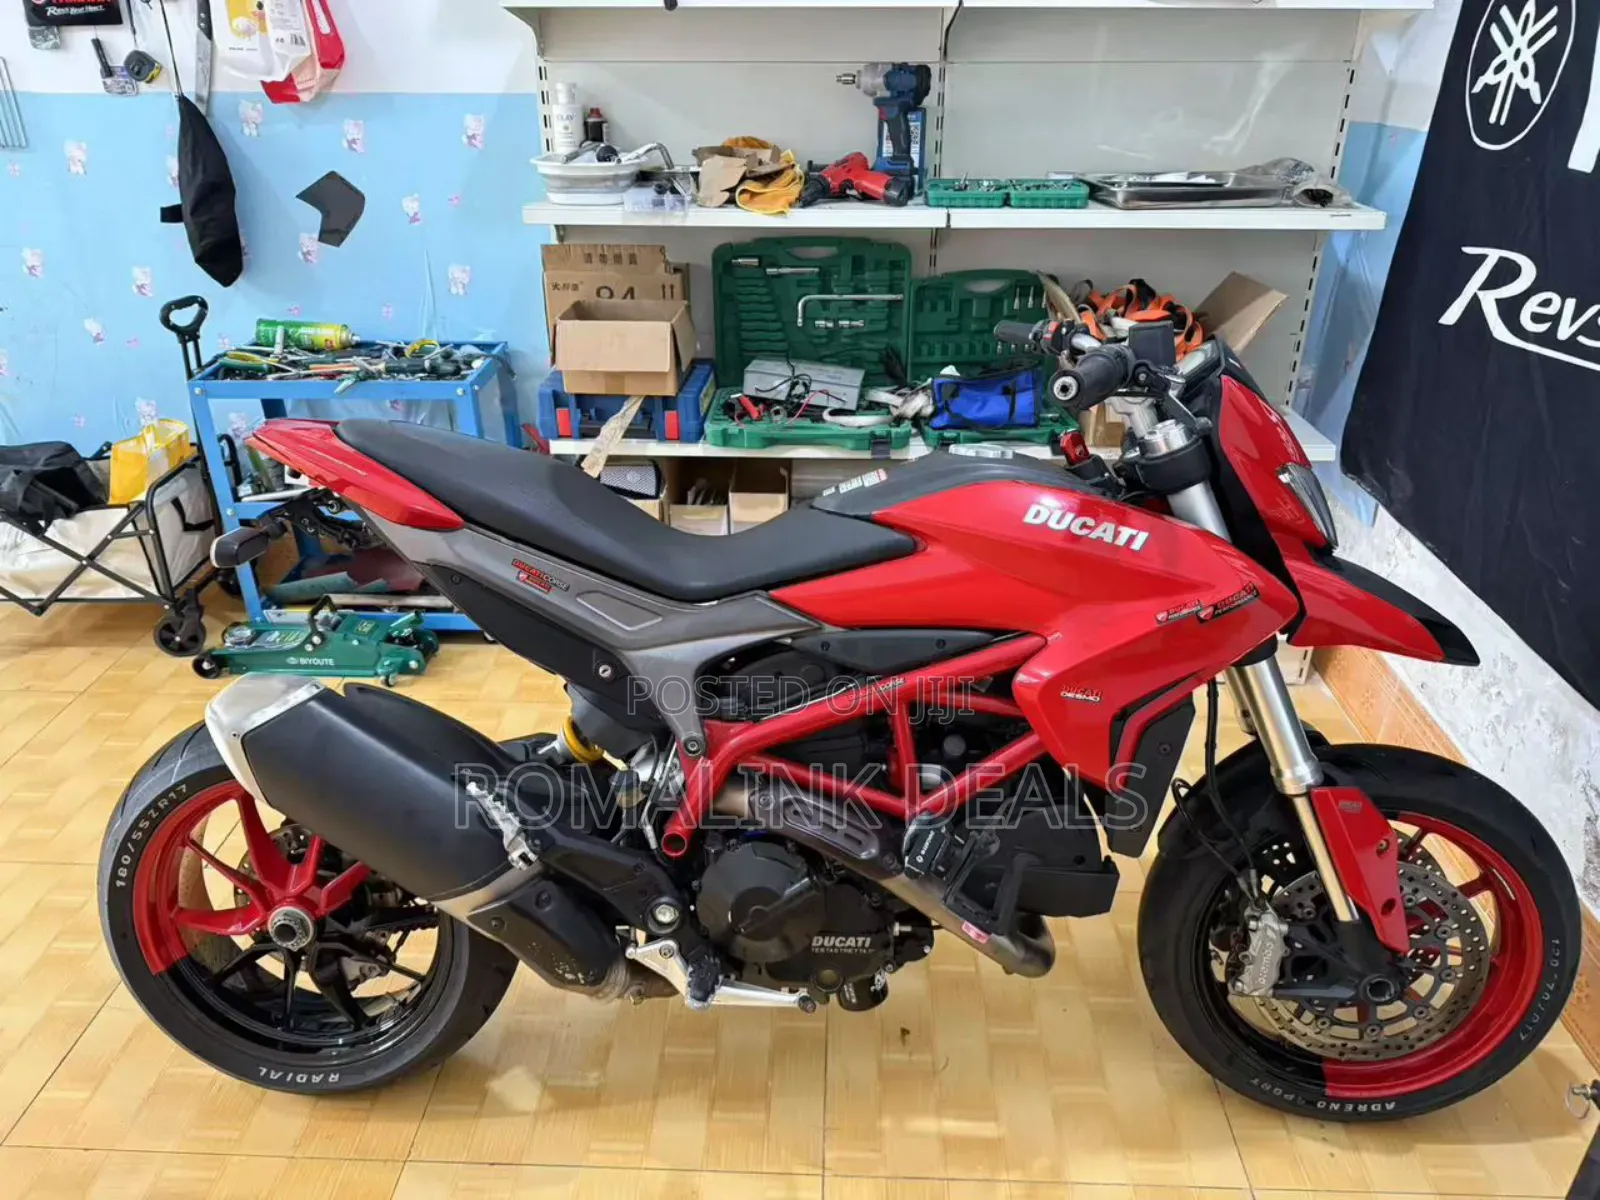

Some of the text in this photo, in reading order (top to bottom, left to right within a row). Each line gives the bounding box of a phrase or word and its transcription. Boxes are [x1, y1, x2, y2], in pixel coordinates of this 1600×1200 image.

[1022, 503, 1150, 552] DUCATI
[811, 935, 872, 948] DUCATI
[258, 1066, 341, 1084] RADIAL
[1316, 1101, 1397, 1112] ADRENO
